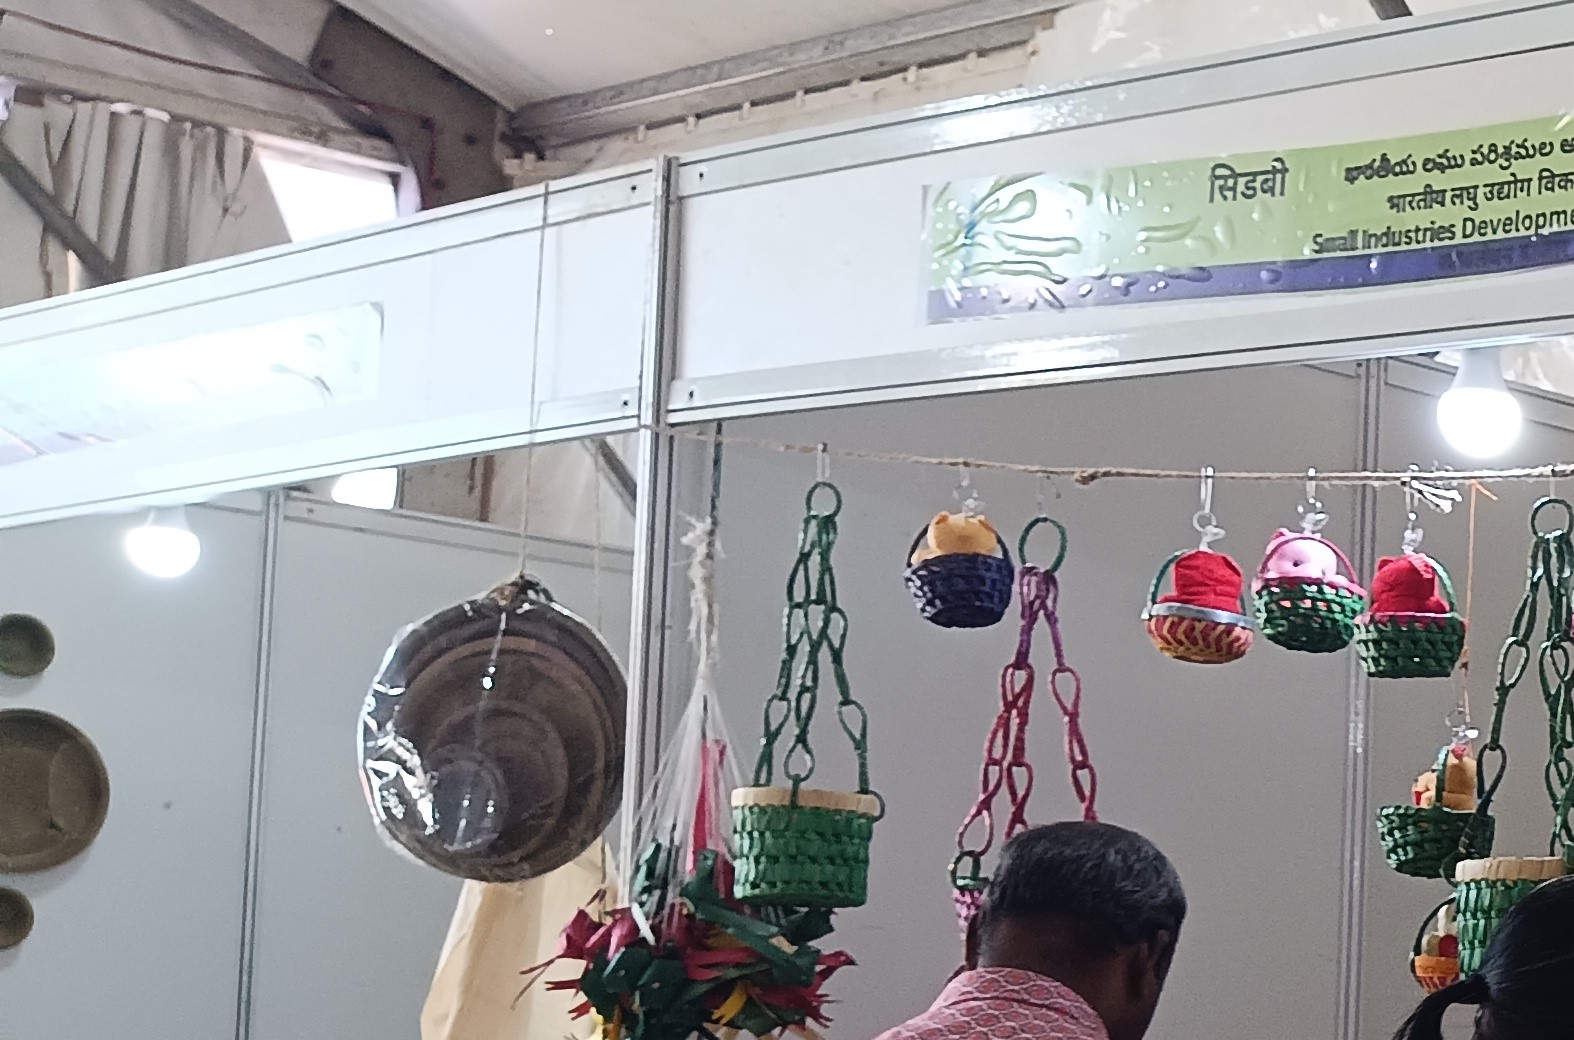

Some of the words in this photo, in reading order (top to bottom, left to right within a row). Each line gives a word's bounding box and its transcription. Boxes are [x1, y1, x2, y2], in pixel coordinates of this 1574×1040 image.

[1208, 157, 1289, 204] सिडबी
[1450, 184, 1480, 211] लघु
[1483, 172, 1533, 202] उद्योग
[1361, 221, 1456, 252] Industries
